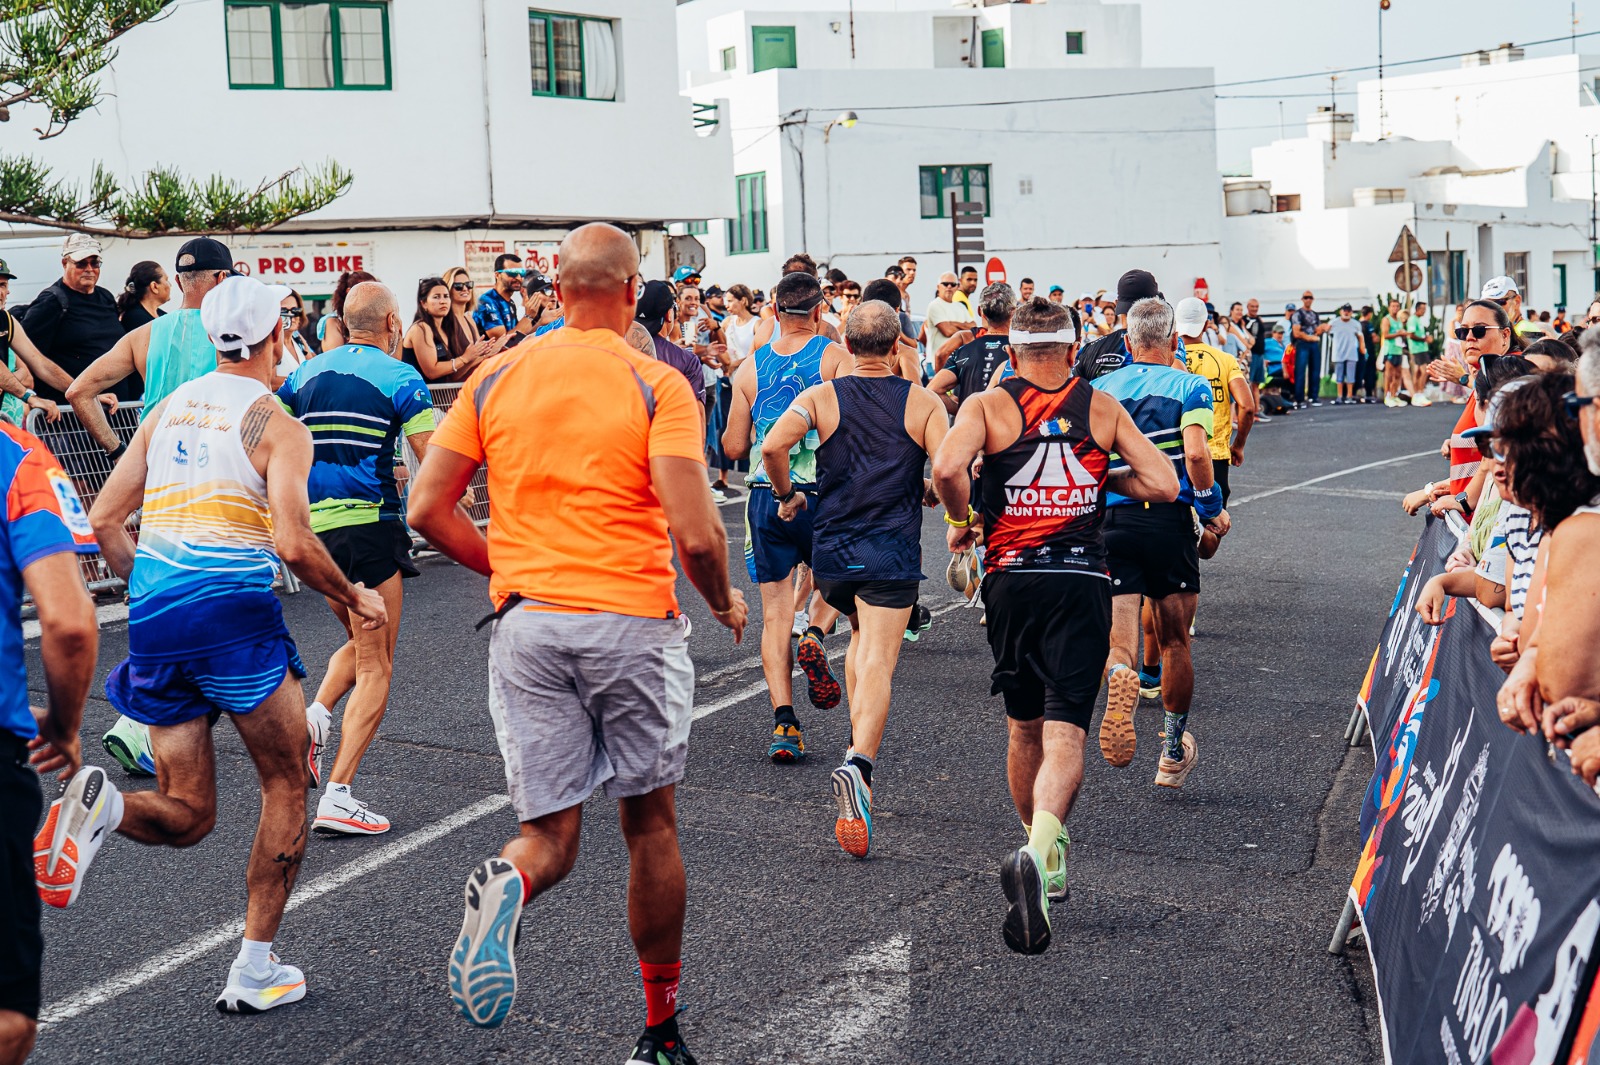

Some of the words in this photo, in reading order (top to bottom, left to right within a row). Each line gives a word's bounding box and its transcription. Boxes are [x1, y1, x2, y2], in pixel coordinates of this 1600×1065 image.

[258, 257, 305, 274] PRO
[313, 255, 363, 273] BIKE
[1004, 486, 1099, 505] VOLCAN
[1005, 505, 1033, 517] RUN
[1034, 504, 1097, 517] TRAINING
